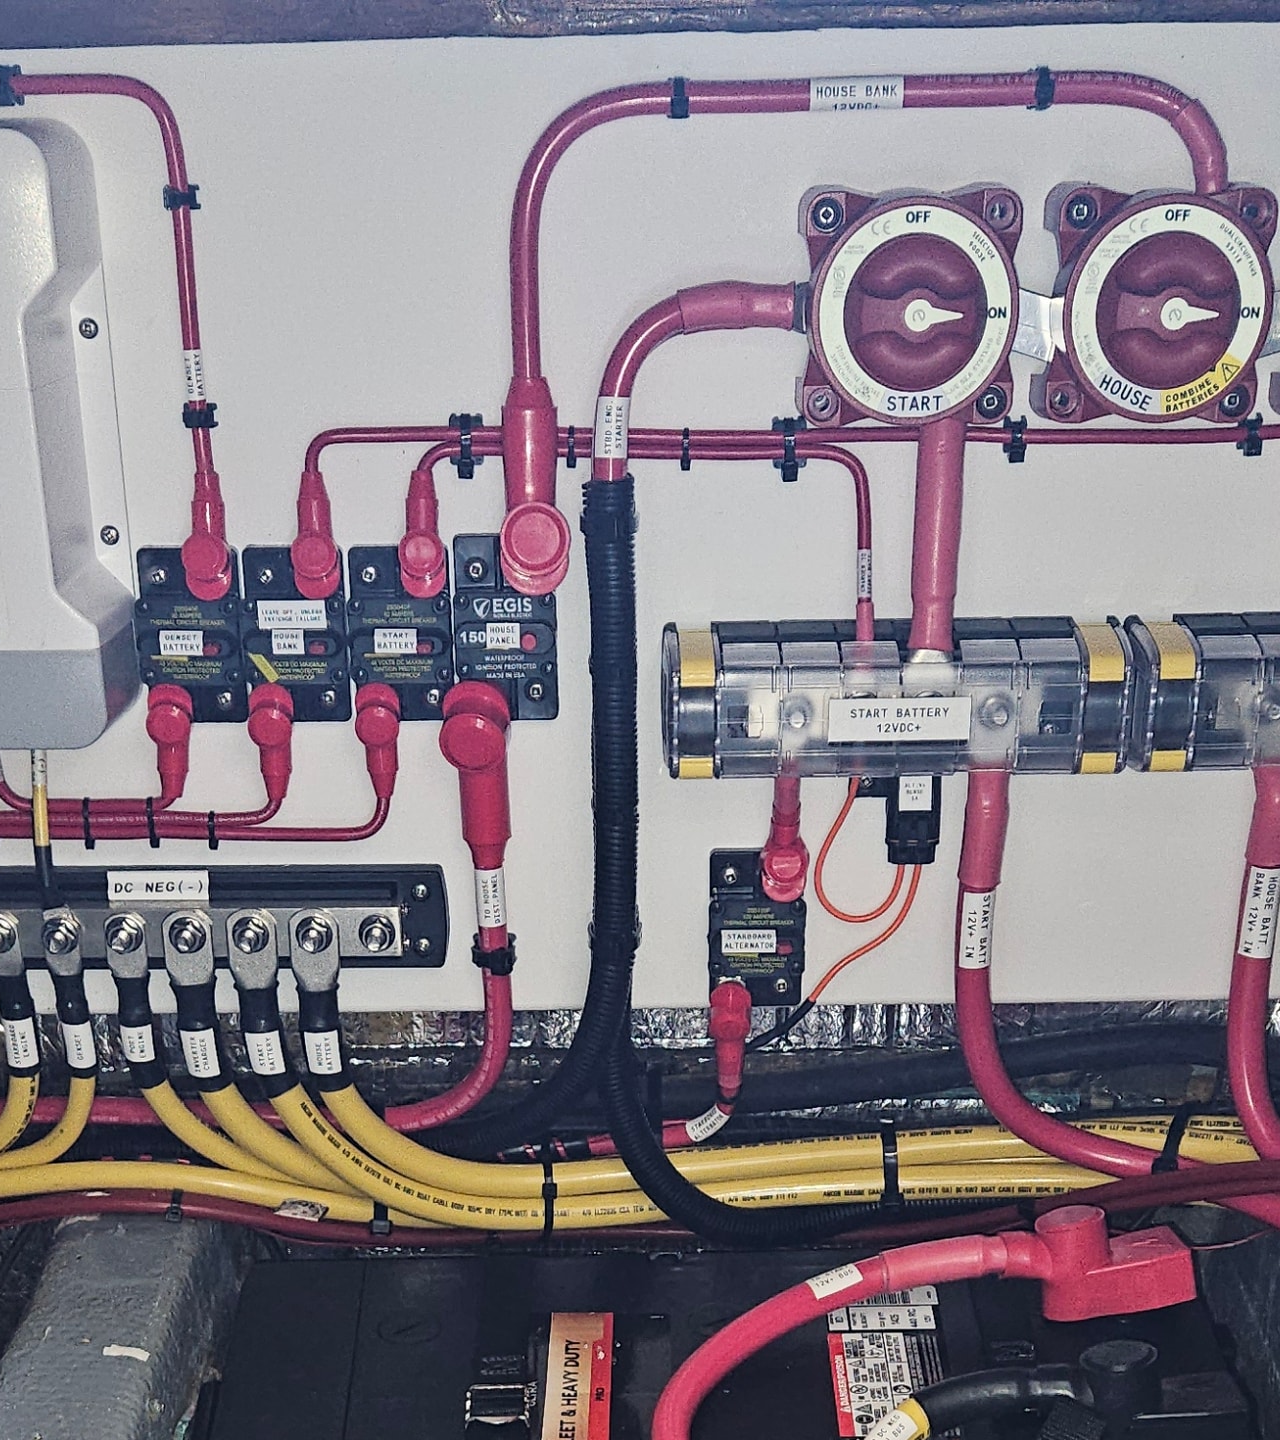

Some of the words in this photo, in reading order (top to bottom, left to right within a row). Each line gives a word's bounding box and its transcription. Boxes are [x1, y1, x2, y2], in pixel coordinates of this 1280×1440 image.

[816, 85, 856, 98] HOUSE
[865, 84, 898, 97] BANK
[905, 210, 931, 224] OFF
[1164, 209, 1191, 222] OFF
[972, 231, 996, 260] SELECTOR
[988, 307, 1007, 319] ON
[1241, 307, 1260, 319] ON
[1099, 374, 1153, 412] HOUSE
[1165, 378, 1212, 402] COMBINE
[1165, 383, 1220, 413] BATTERIES
[887, 395, 943, 412] START
[615, 405, 623, 449] STARTER
[493, 598, 533, 612] EGIS
[273, 632, 300, 640] HOUSE
[459, 631, 486, 643] 150
[489, 625, 516, 634] HOUSE
[163, 643, 202, 652] BATTERY
[276, 642, 298, 650] BANK
[377, 641, 415, 650] BATTERY
[489, 636, 517, 645] PANEL
[850, 707, 891, 719] START
[896, 707, 950, 719] BATTERY
[877, 722, 922, 734] 12VDC+
[114, 881, 133, 894] DC
[145, 879, 205, 896] NEG(-)
[481, 880, 490, 904] HOUSE
[1251, 872, 1265, 902] BANK
[1262, 876, 1278, 911] HOUSE
[484, 909, 491, 919] TO
[981, 894, 992, 929] START
[1246, 904, 1259, 935] 12V+
[966, 908, 978, 938] 12V+
[727, 932, 773, 940] STARBOARD
[723, 941, 775, 950] ALTERNATOR
[964, 944, 974, 959] IN
[978, 935, 988, 965] BATT
[1243, 940, 1253, 956] IN
[8, 1024, 22, 1065] STARBOARD
[19, 1031, 30, 1058] ENGINE
[74, 1034, 83, 1061] GENSET
[127, 1035, 135, 1054] PORT
[136, 1031, 147, 1059] ENGINE
[189, 1036, 202, 1073] INVERTER
[198, 1037, 210, 1071] CHARGER
[256, 1042, 267, 1066] START
[264, 1037, 277, 1071] BATTERY
[323, 1036, 334, 1071] BATTERY
[838, 1268, 855, 1280] BUS
[564, 1339, 581, 1369] DUTY
[561, 1370, 579, 1406] HEAVY
[595, 1387, 605, 1402] PRO
[561, 1407, 576, 1418] &
[879, 1425, 889, 1438] DC
[893, 1424, 906, 1438] BUS
